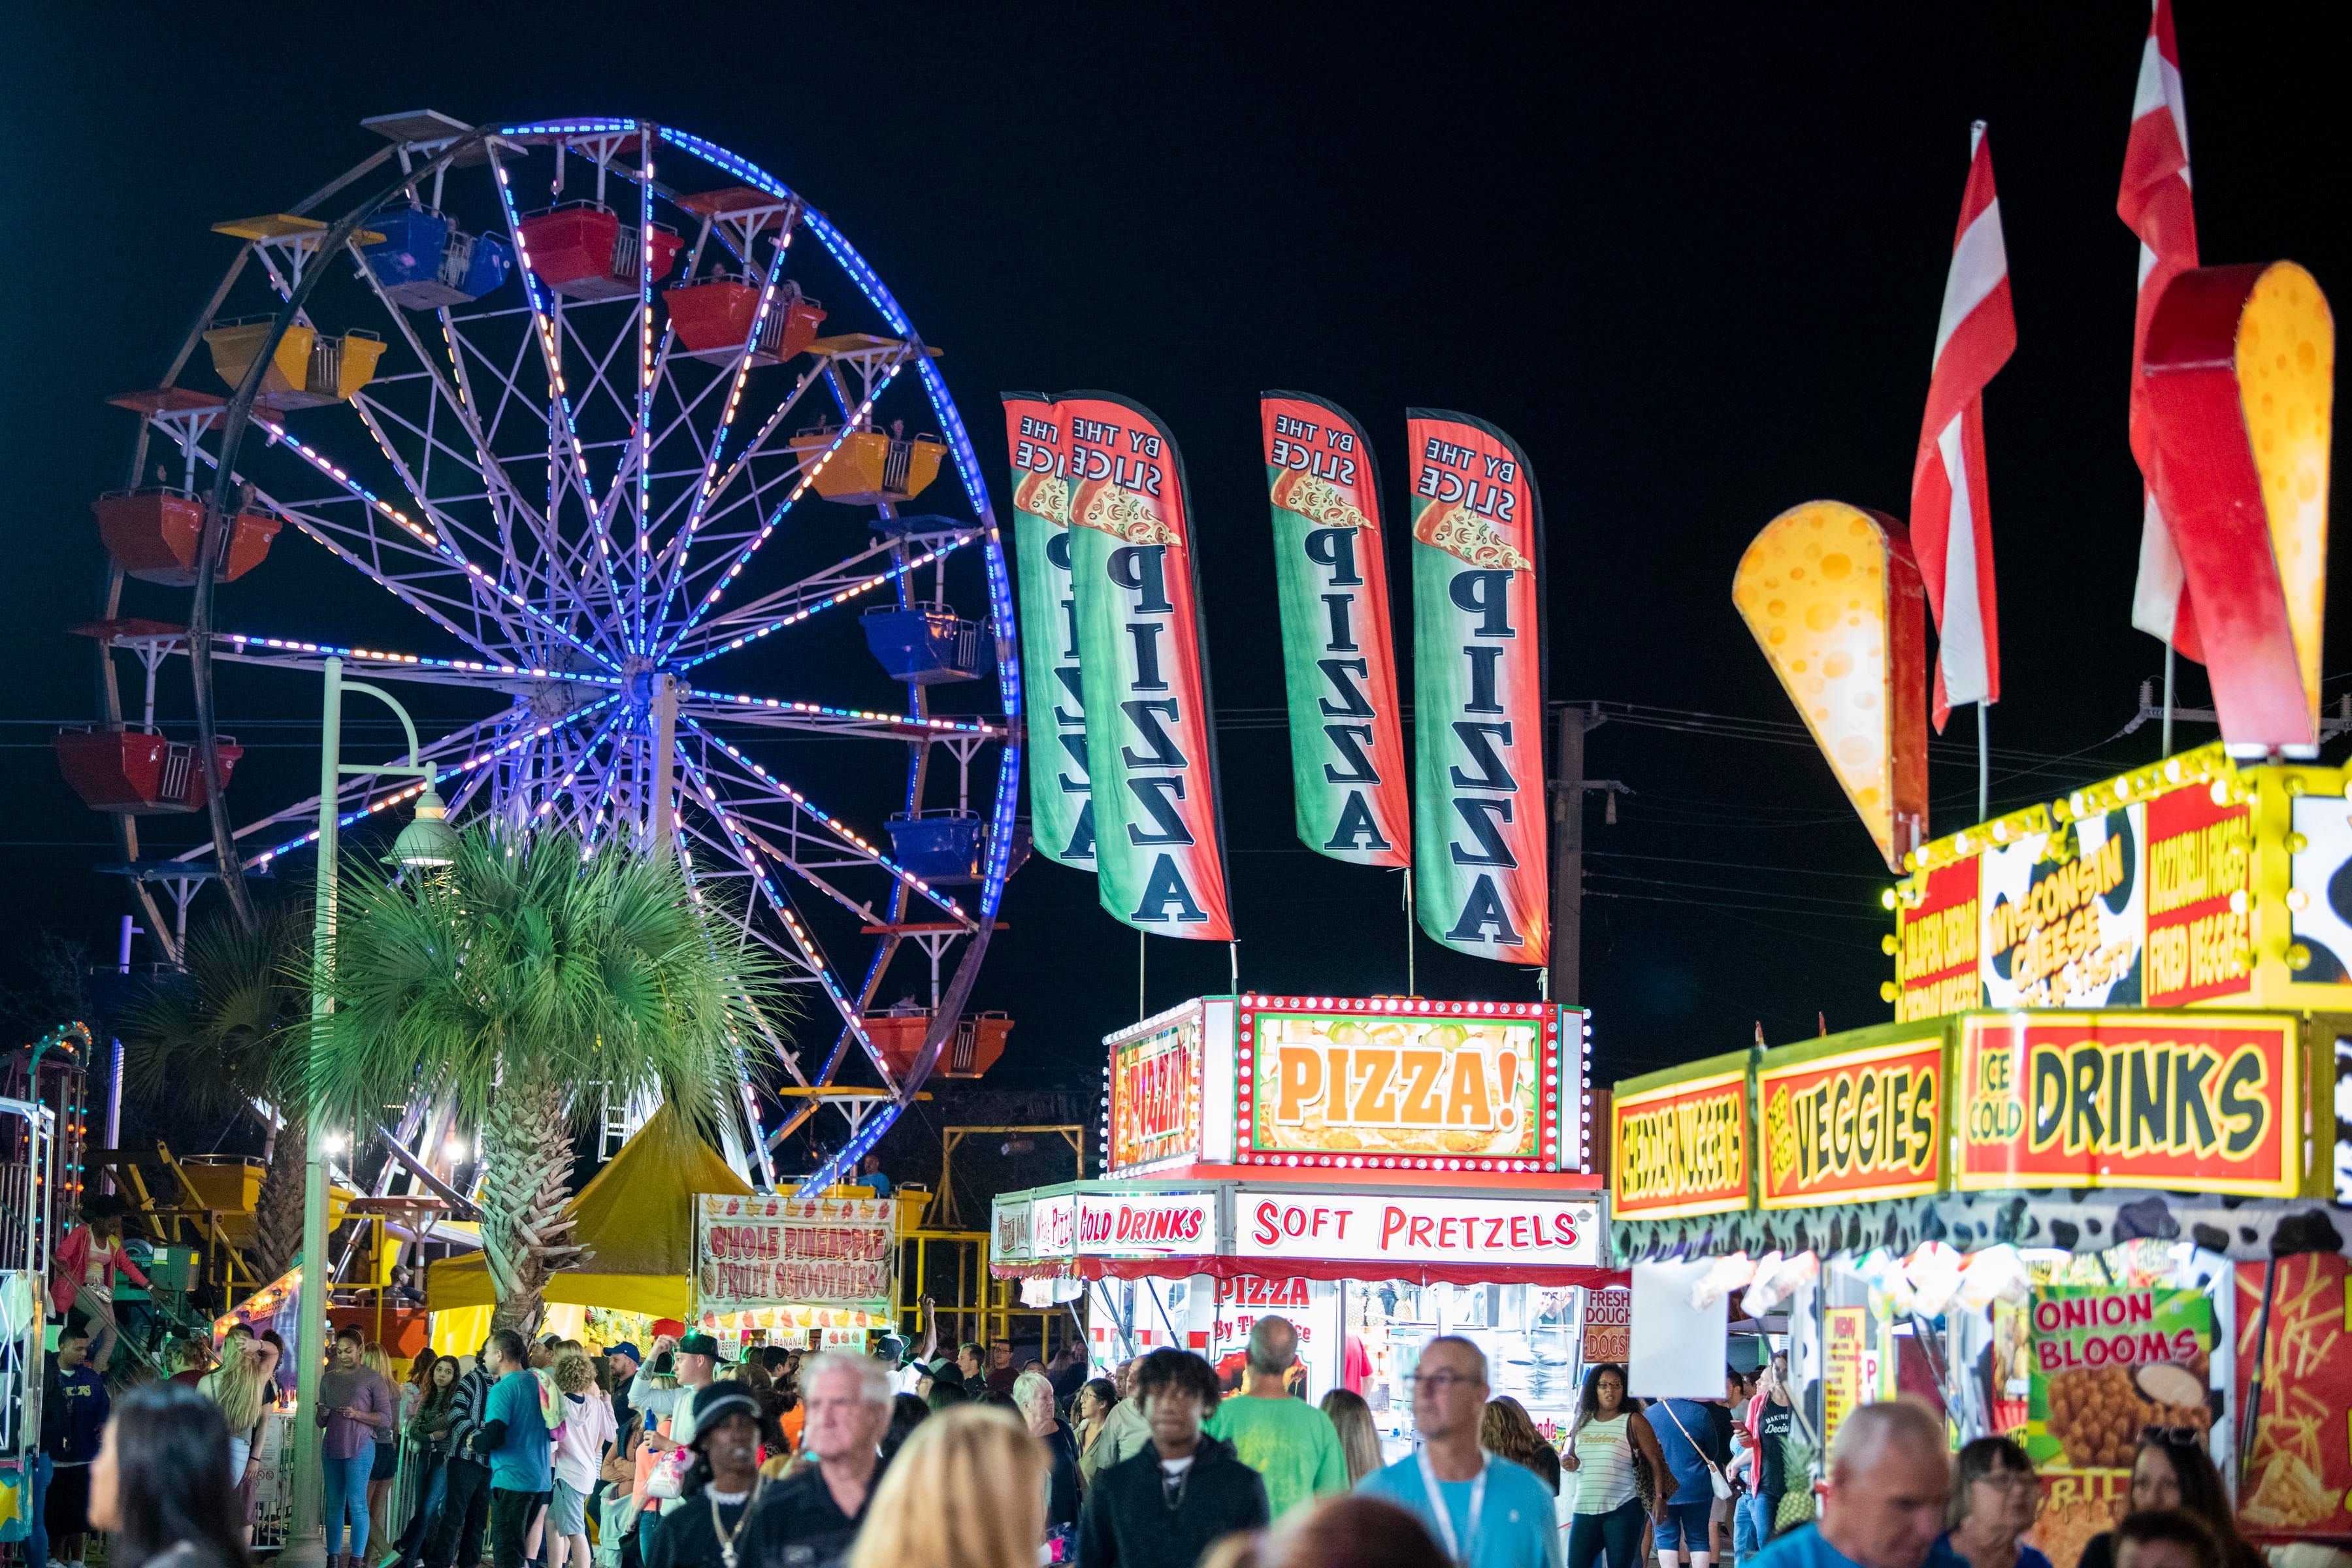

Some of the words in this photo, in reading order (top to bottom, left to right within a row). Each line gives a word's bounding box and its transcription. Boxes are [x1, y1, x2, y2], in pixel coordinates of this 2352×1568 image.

[1987, 834, 2124, 956] WISCONSIN
[2011, 903, 2102, 992] CHEESE
[2149, 923, 2188, 998] FRIED
[2189, 910, 2249, 988] VEGGIES
[1275, 1043, 1520, 1132] PIZZA!
[1978, 1051, 2012, 1092] ICE
[1128, 1044, 1188, 1146] PIZZA!
[2029, 1040, 2271, 1162] DRINKS
[1791, 1064, 1936, 1190] VEGGIES
[1968, 1098, 2024, 1142] COLD
[710, 1226, 780, 1260] WHOLE
[784, 1227, 886, 1262] PINEAPPLE
[1079, 1202, 1114, 1244] COLD
[1115, 1204, 1205, 1243] DRINKS
[1252, 1199, 1354, 1248] SOFT
[1378, 1203, 1580, 1252] PRETZELS
[716, 1262, 770, 1304] FRUIT
[774, 1262, 879, 1299] SMOOTHIES
[1213, 1277, 1310, 1307] PIZZA
[1590, 1290, 1630, 1307] FRESH
[1213, 1320, 1233, 1341] By
[1237, 1315, 1258, 1335] Th
[1586, 1307, 1631, 1324] DOUGH
[2035, 1292, 2153, 1332] ONION
[774, 1337, 802, 1347] BANANA
[2038, 1328, 2199, 1371] BLOOMS
